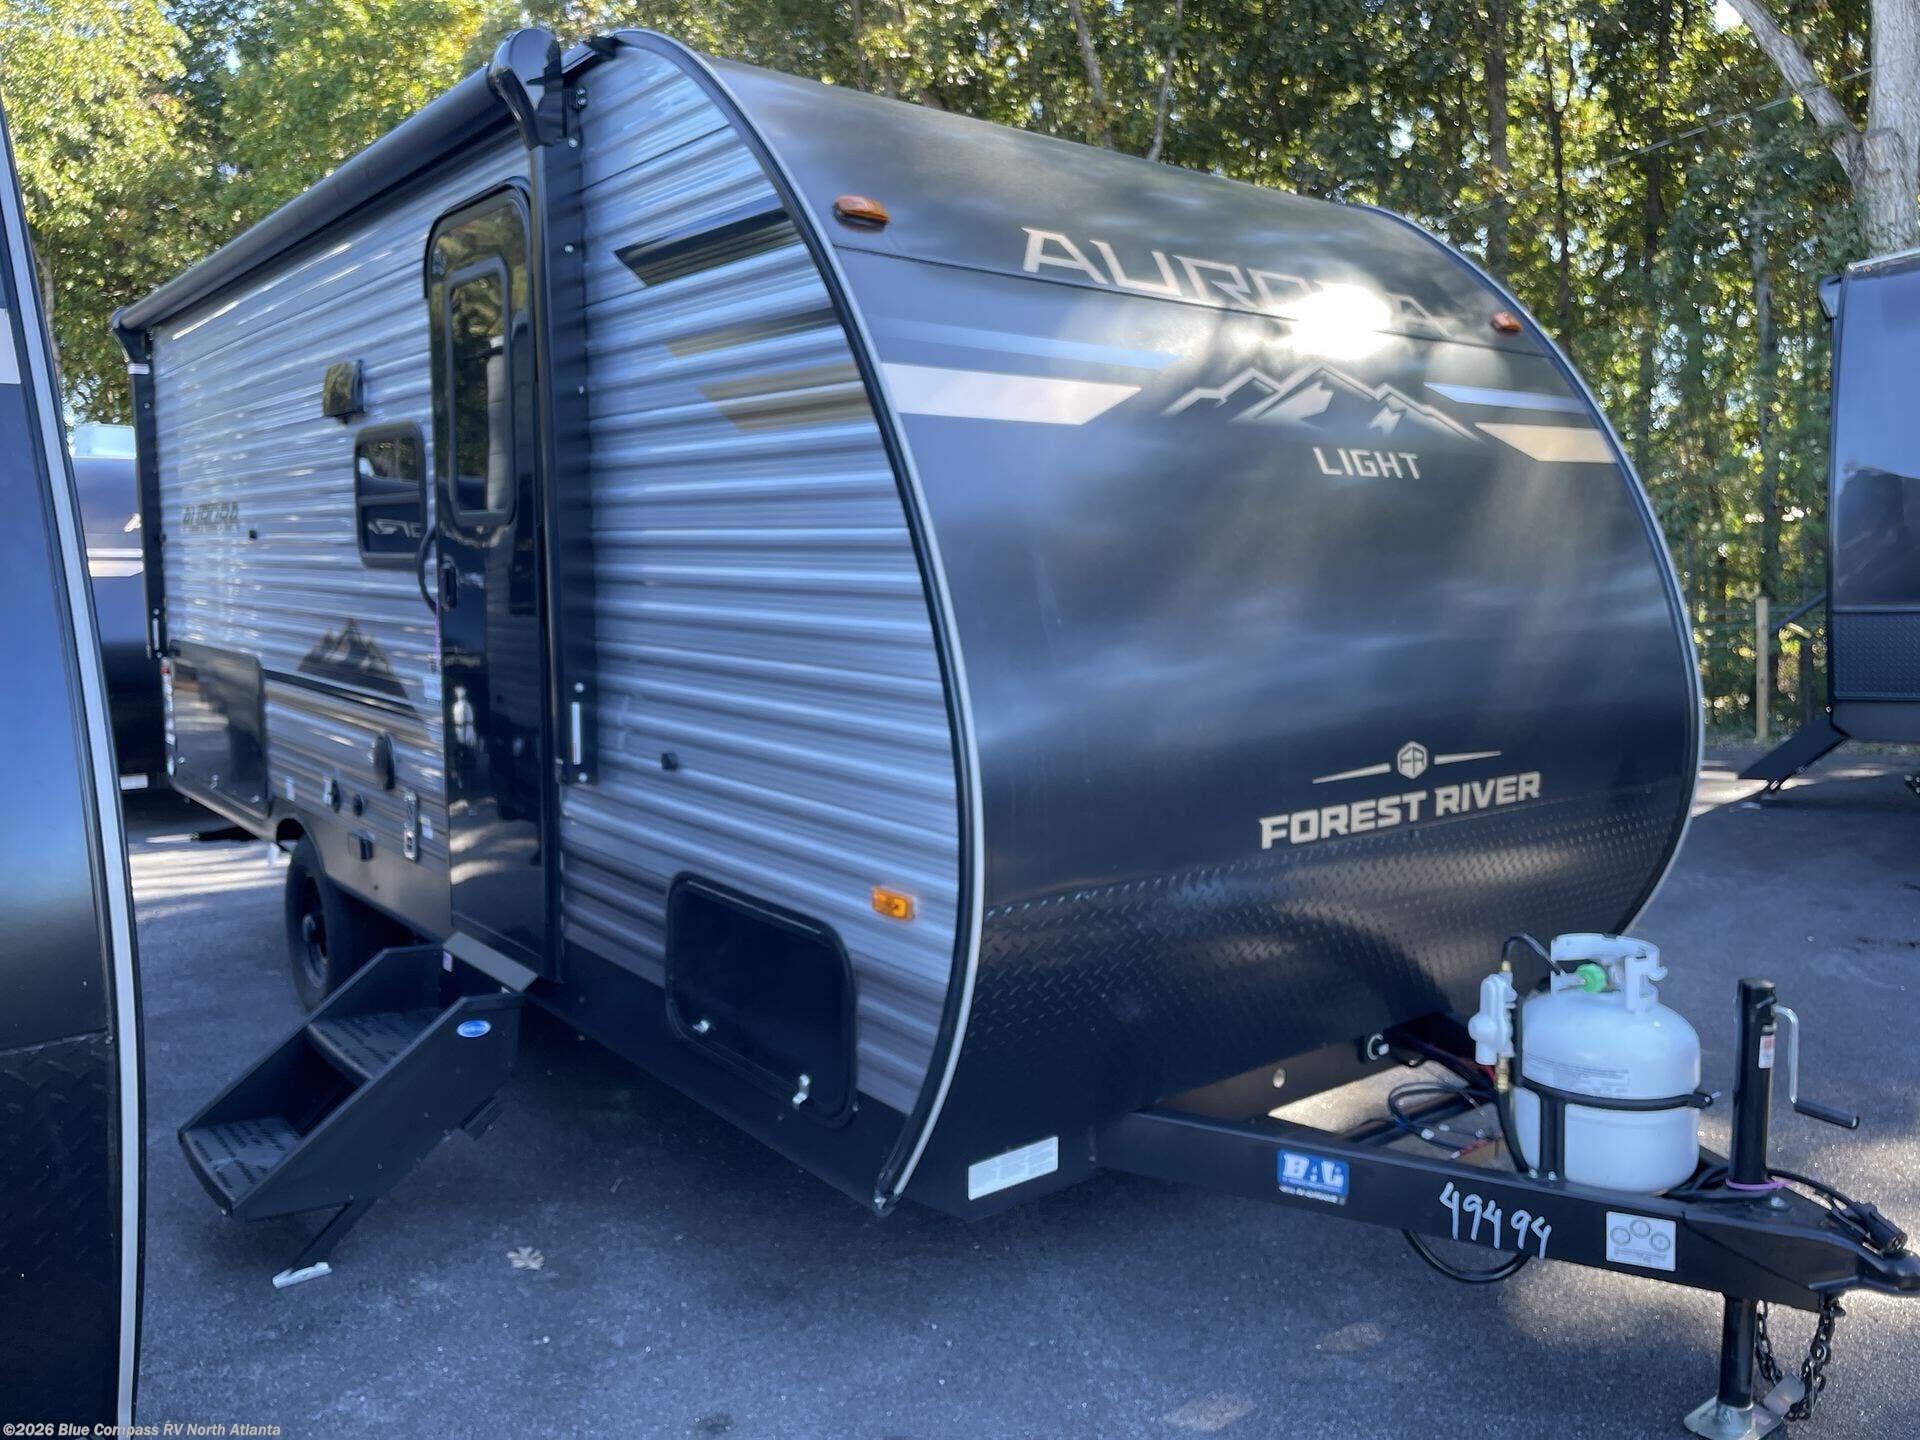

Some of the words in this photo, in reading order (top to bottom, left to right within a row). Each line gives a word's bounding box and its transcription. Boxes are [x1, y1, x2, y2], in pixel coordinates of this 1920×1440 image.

[1021, 226, 1450, 337] AUROA
[1312, 446, 1420, 480] LIGHT
[1259, 790, 1427, 850] FOREST
[1434, 770, 1541, 817] RIVER
